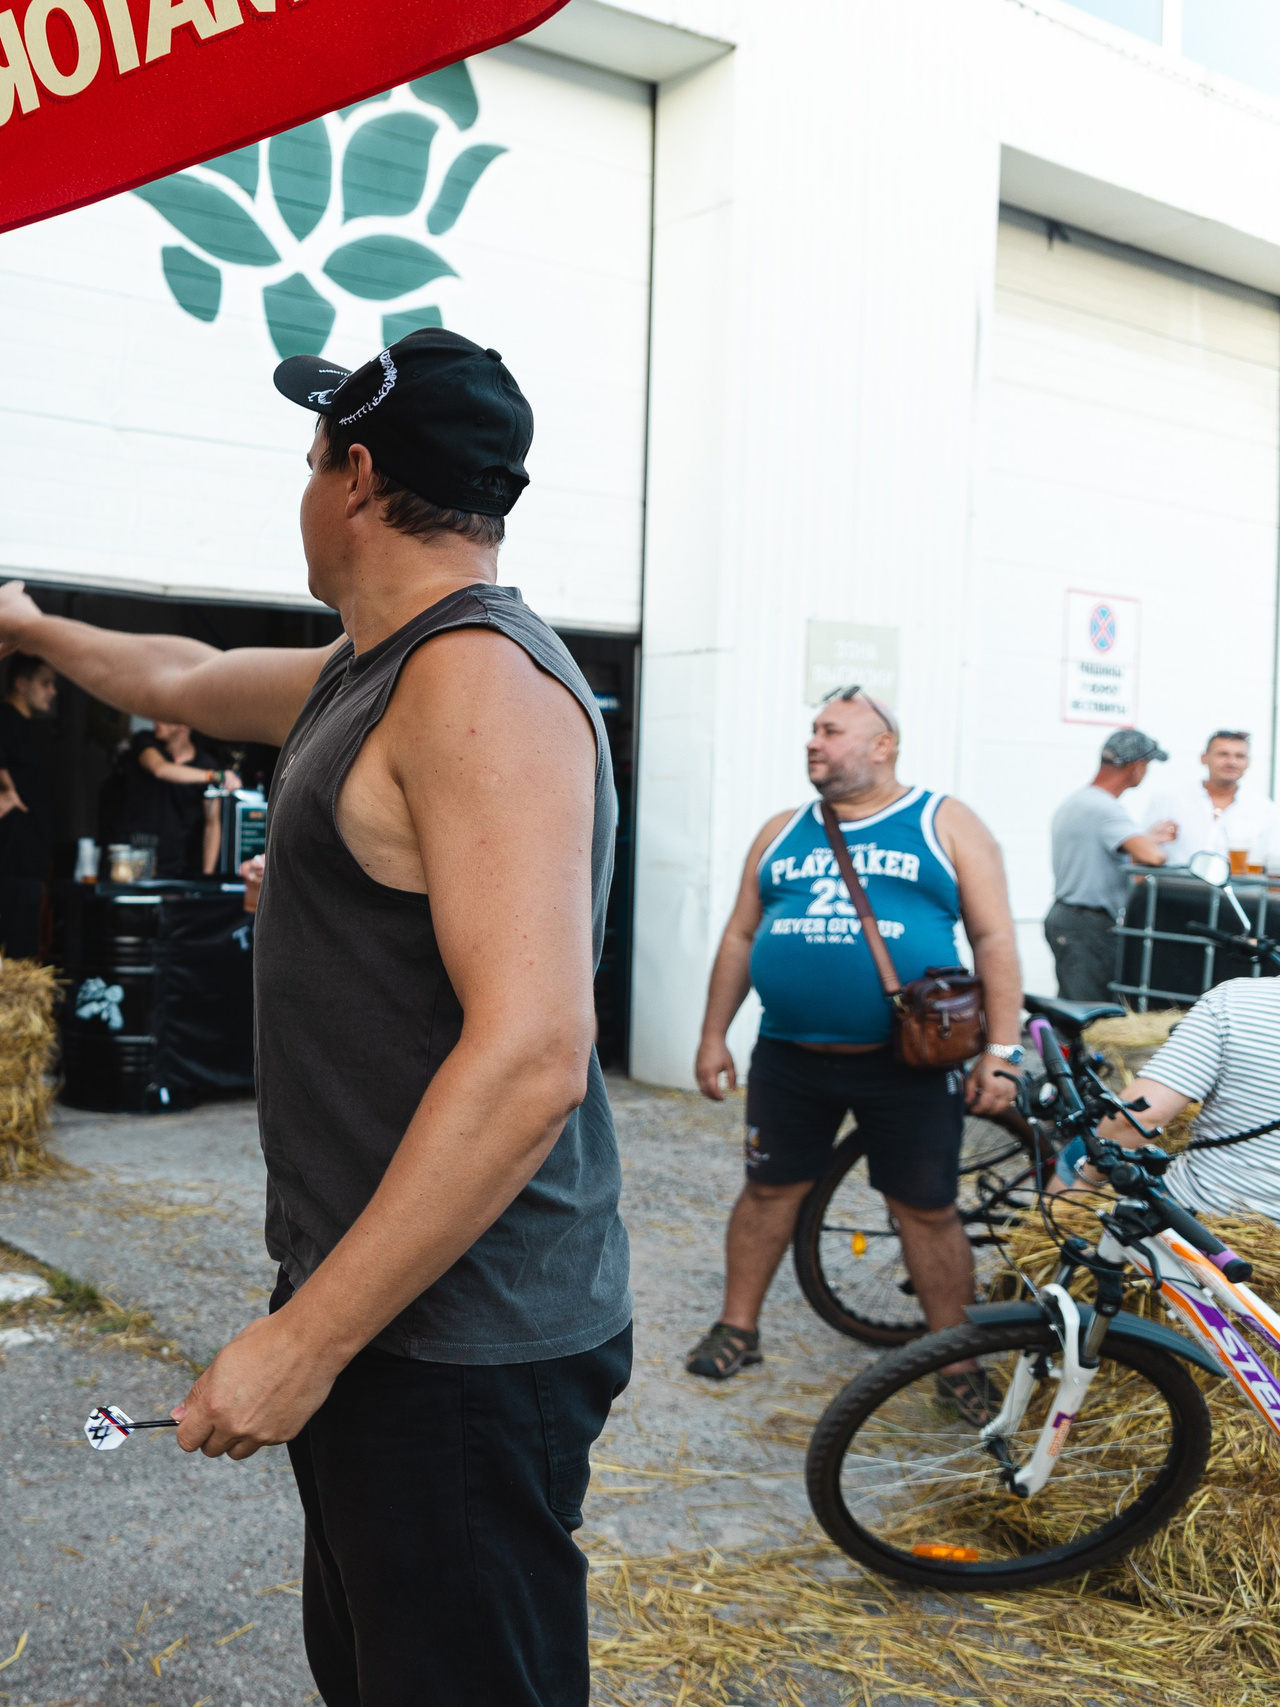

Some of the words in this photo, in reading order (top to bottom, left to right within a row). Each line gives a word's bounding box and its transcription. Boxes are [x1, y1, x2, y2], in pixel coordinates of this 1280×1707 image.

[770, 917, 826, 935] NEVER
[827, 917, 862, 936] GIV
[877, 919, 906, 940] UP
